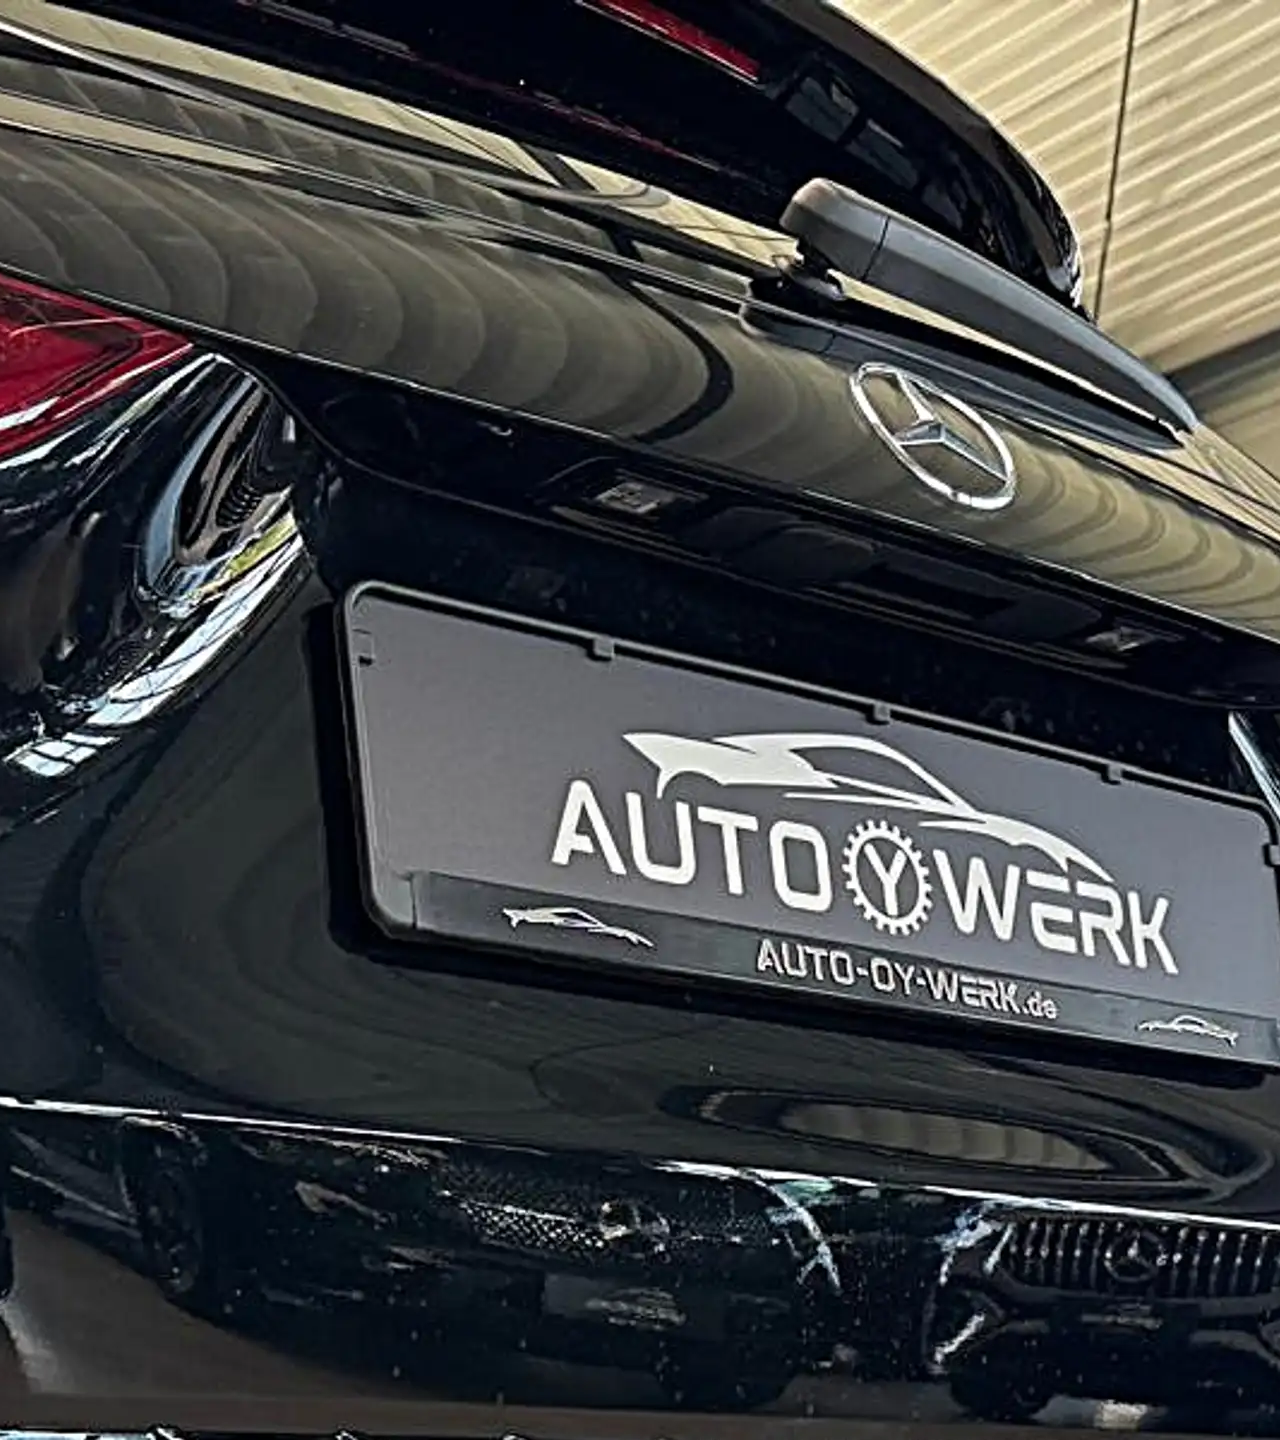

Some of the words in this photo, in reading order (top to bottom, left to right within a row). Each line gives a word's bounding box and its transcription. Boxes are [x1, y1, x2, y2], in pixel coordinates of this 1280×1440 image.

[551, 779, 833, 912] AUTO
[933, 849, 1179, 976] WERK
[757, 938, 1058, 1019] AUTO-OY-WERK.de
